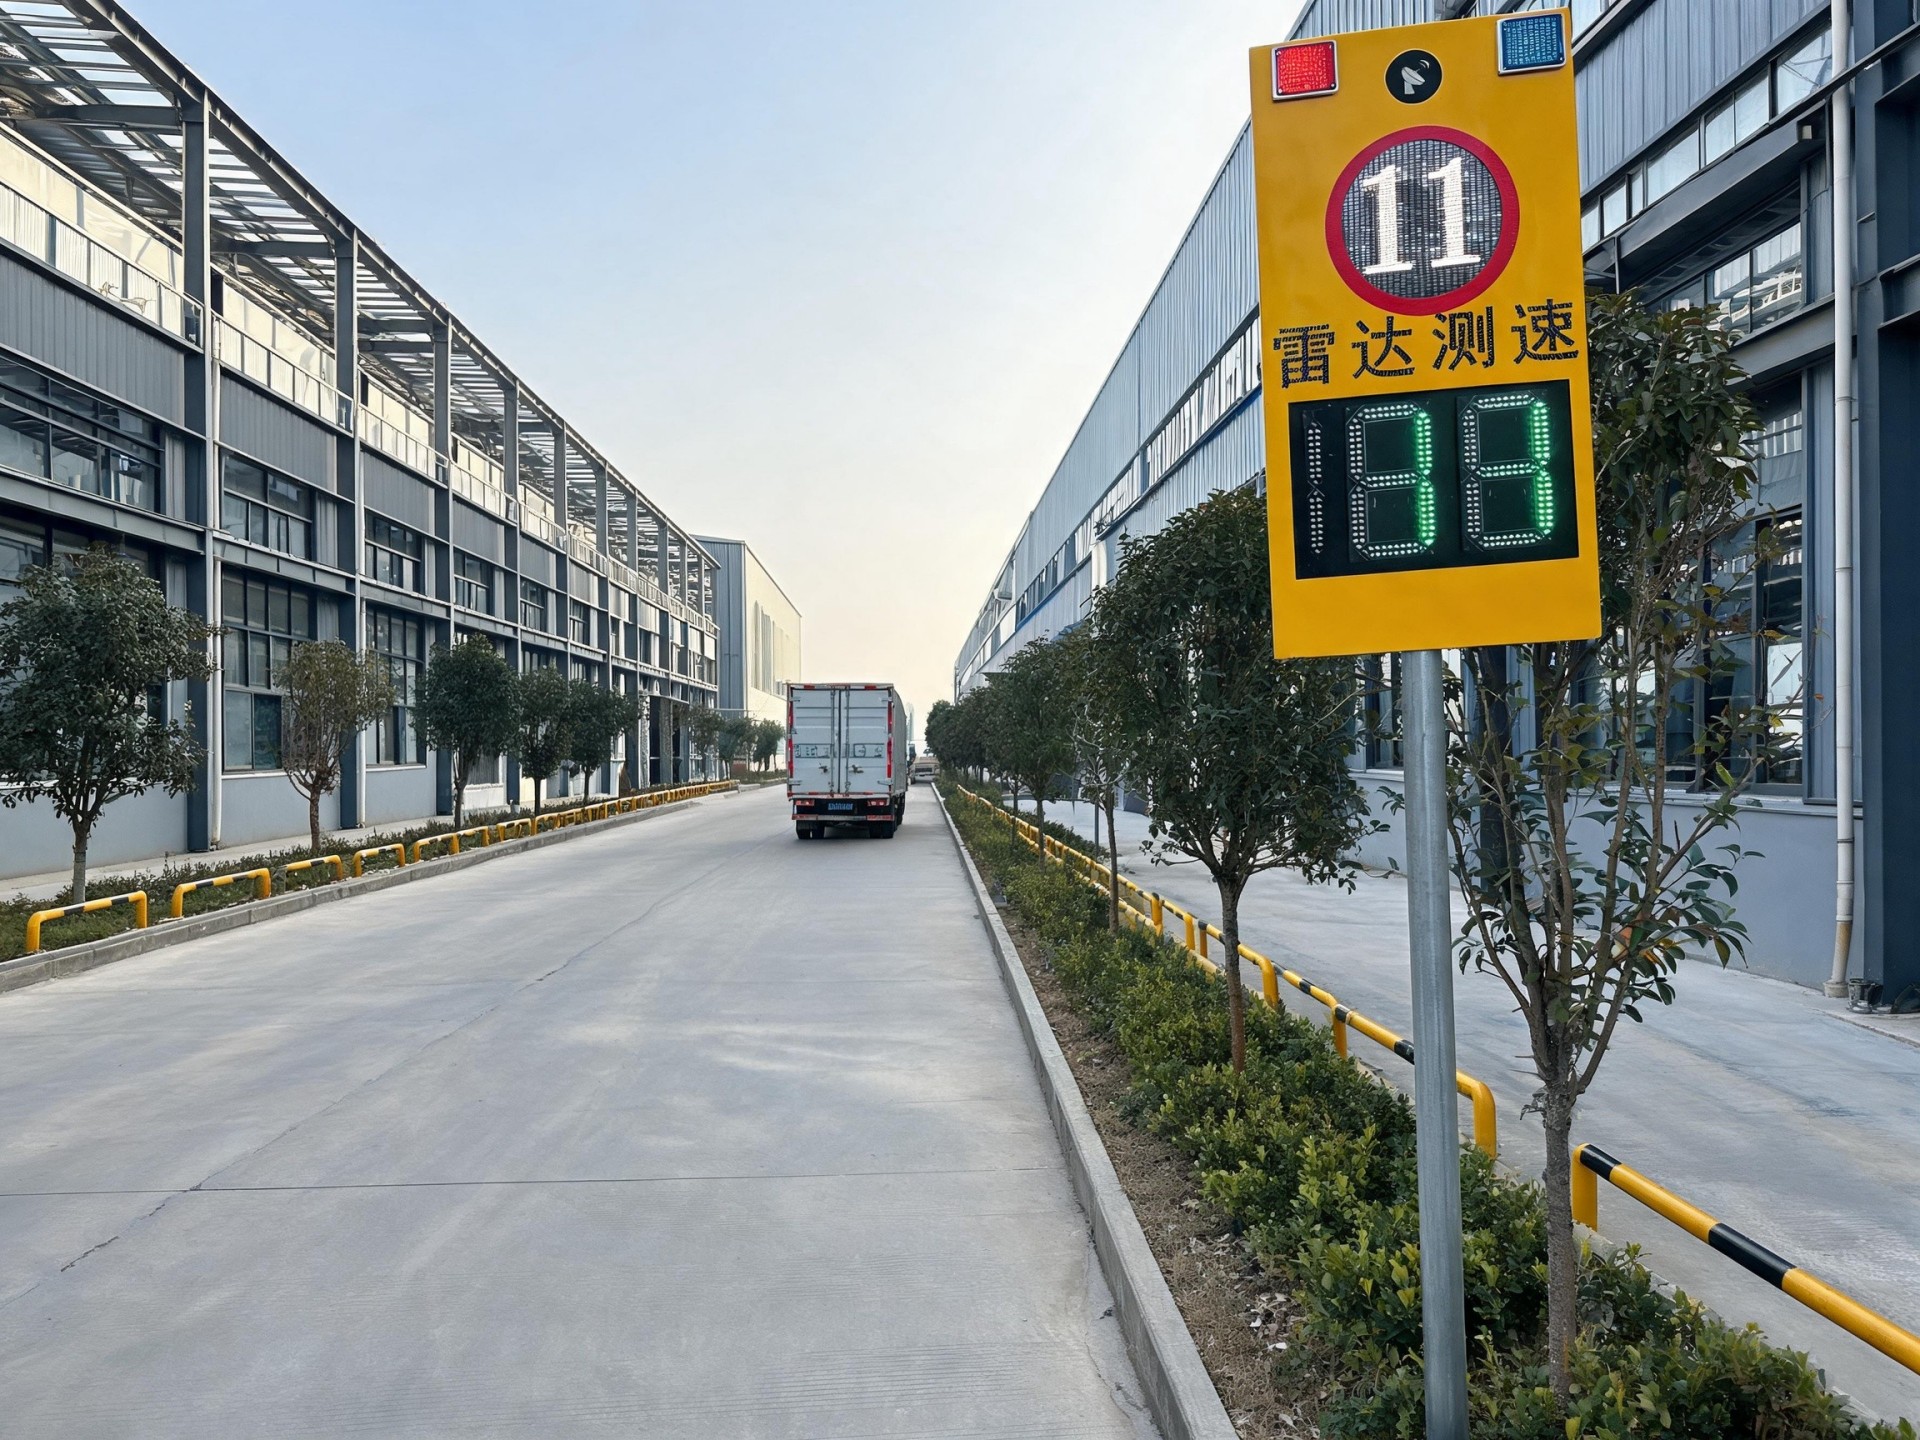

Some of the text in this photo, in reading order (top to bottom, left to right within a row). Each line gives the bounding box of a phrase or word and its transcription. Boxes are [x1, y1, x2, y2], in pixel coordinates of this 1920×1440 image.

[1362, 156, 1481, 275] 11
[1273, 299, 1580, 389] 雷达测速
